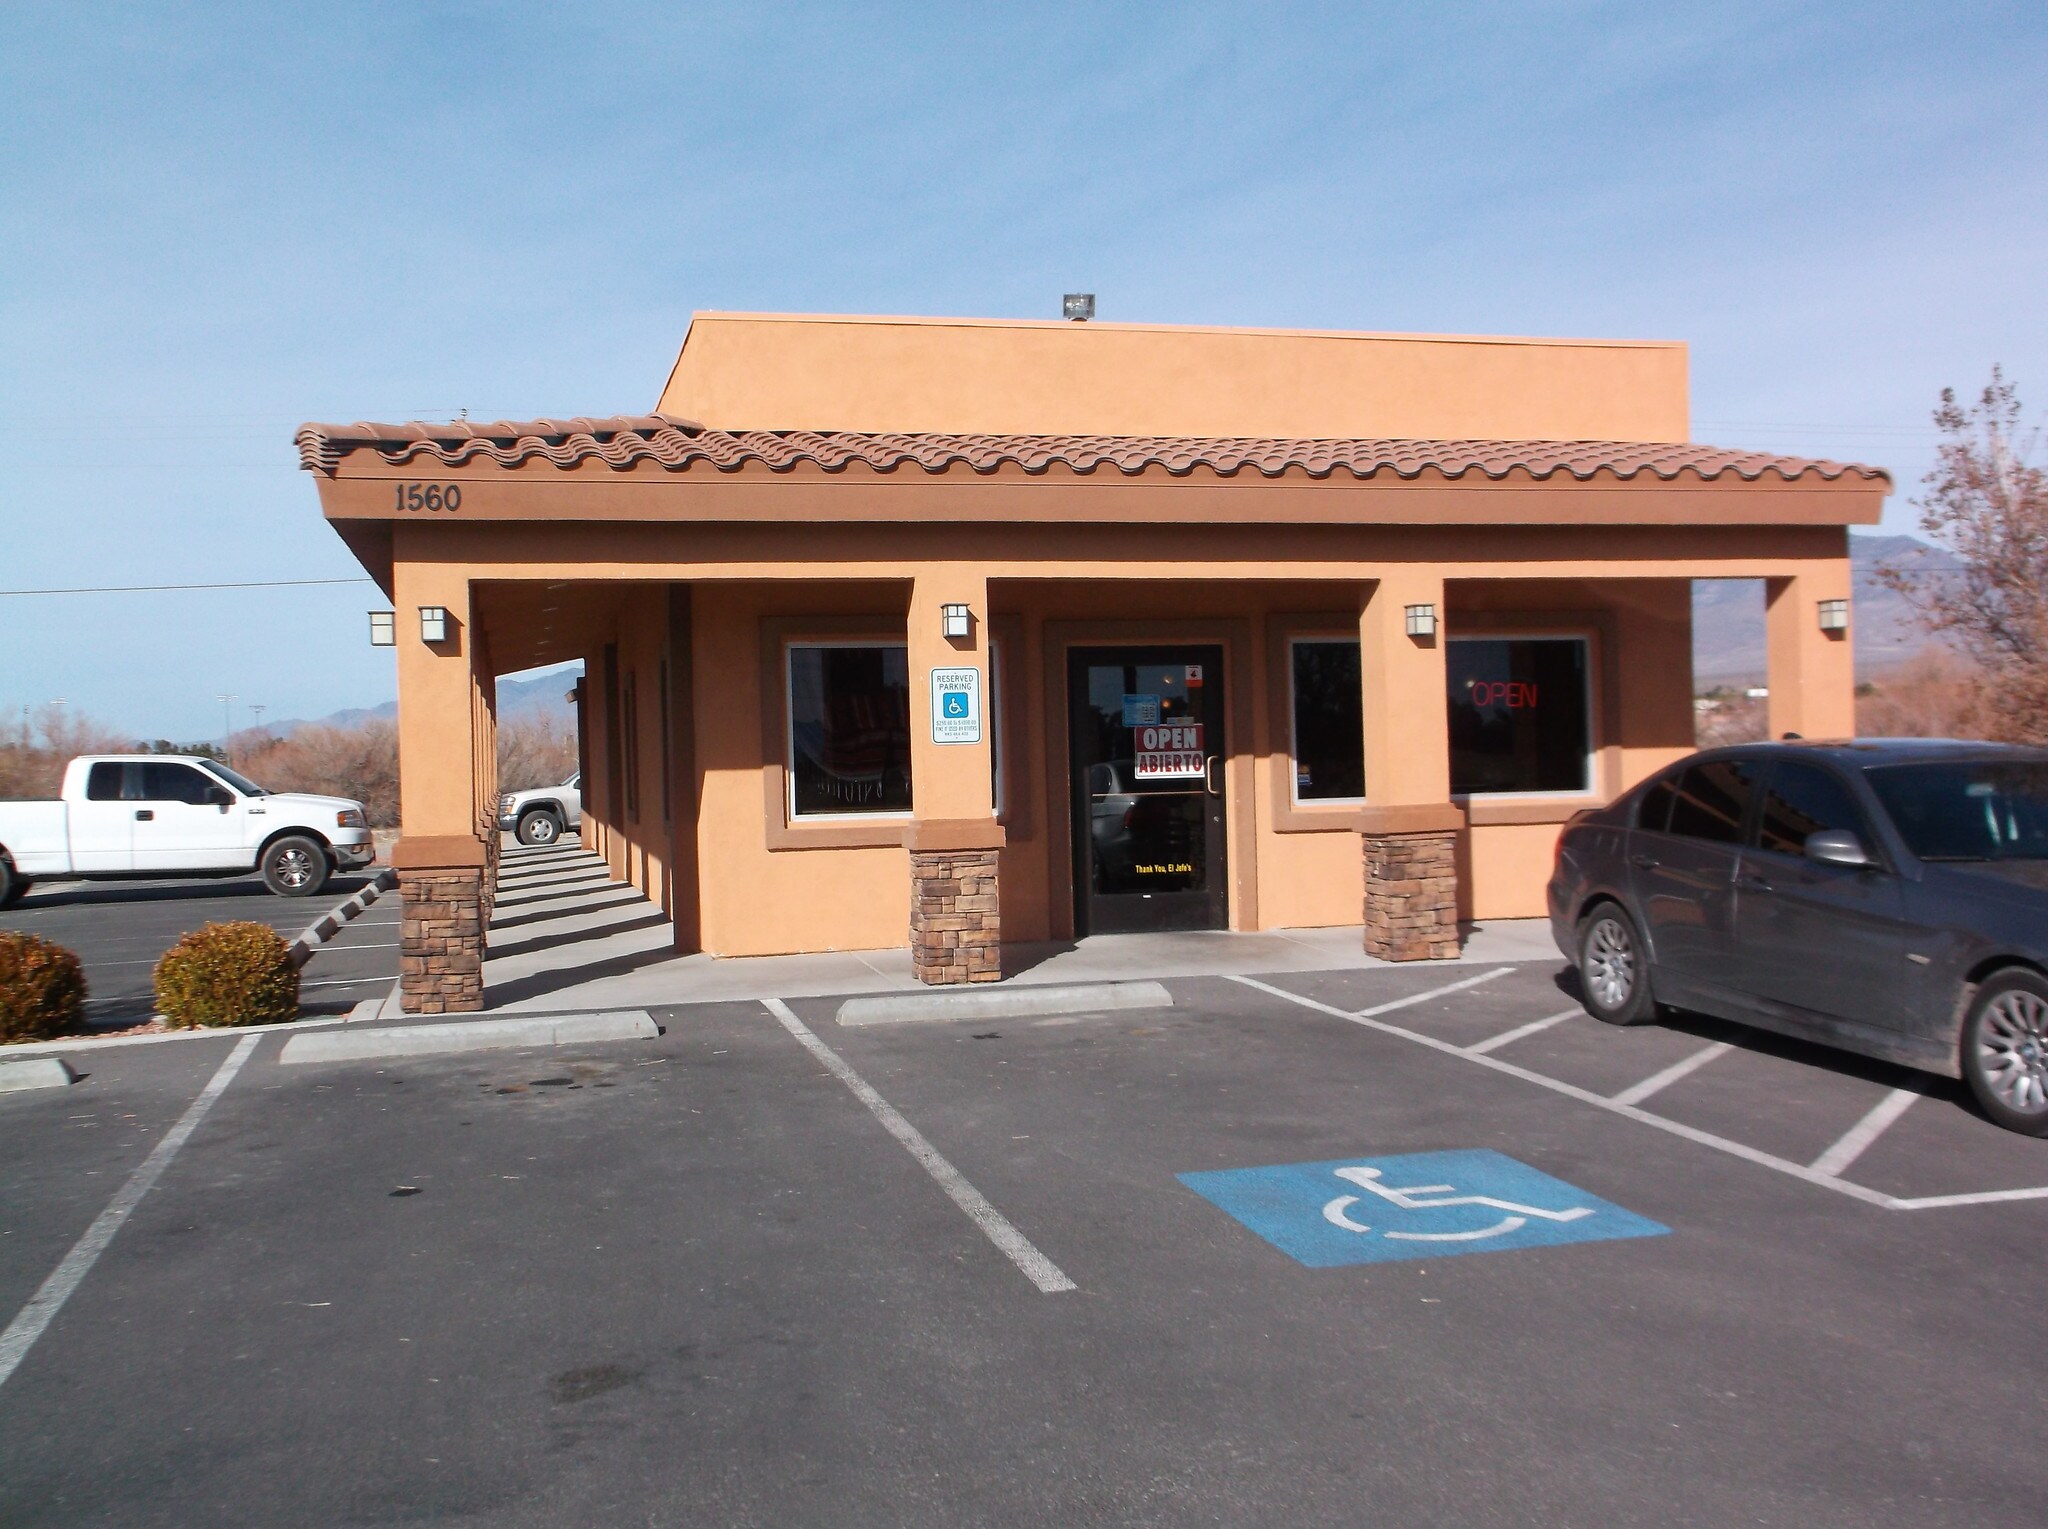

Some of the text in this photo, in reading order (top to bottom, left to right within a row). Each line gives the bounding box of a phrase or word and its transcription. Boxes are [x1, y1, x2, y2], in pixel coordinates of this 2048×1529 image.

[396, 484, 462, 512] 1560
[936, 674, 974, 683] RESERVED
[939, 682, 972, 691] PARKING
[1472, 681, 1538, 708] OPEN
[1143, 728, 1197, 750] OPEN
[1139, 753, 1203, 773] ABIERTO
[1135, 864, 1153, 873] Thank
[1168, 863, 1174, 872] El
